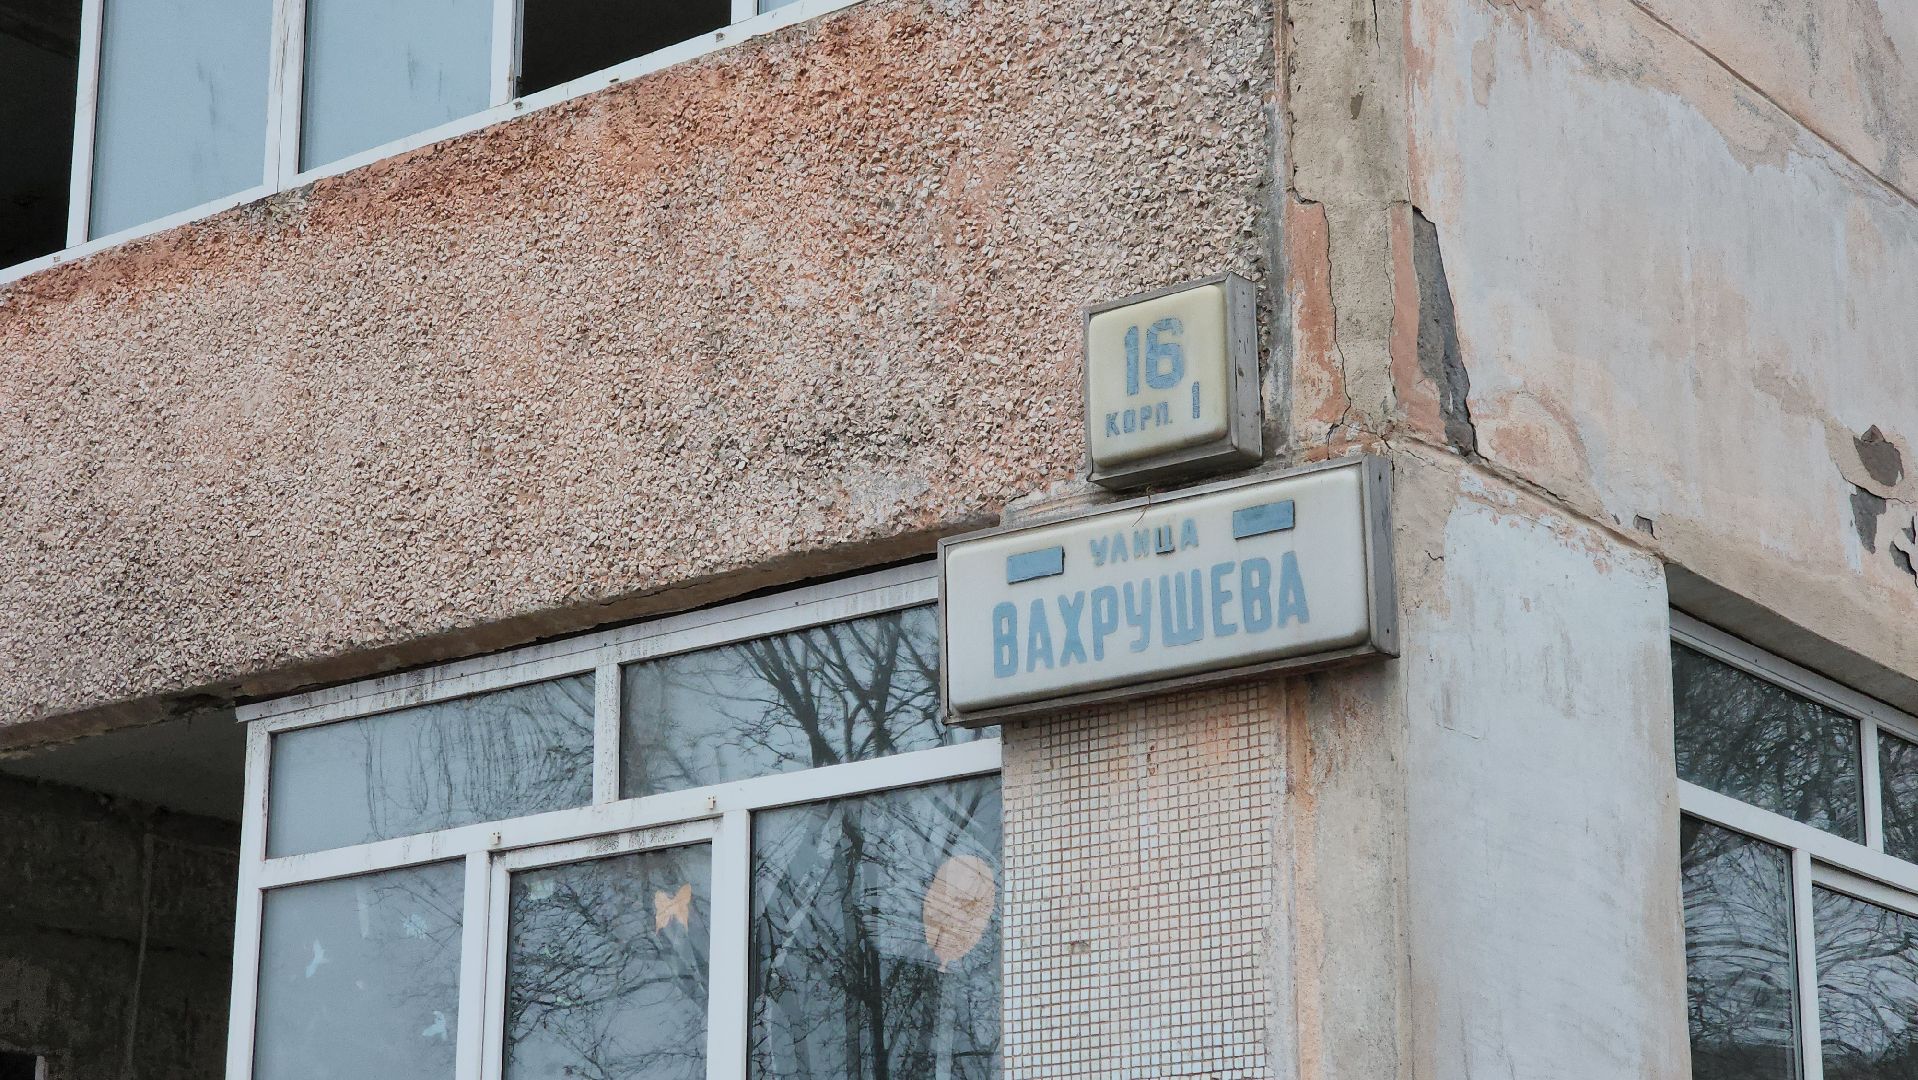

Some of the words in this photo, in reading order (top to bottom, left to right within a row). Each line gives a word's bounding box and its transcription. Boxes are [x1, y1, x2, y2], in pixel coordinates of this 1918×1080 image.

[1124, 316, 1184, 396] 16
[1105, 401, 1173, 437] КОРП.
[1090, 518, 1200, 566] УЛИЦА
[992, 550, 1310, 678] ВАХРУШЕВА
